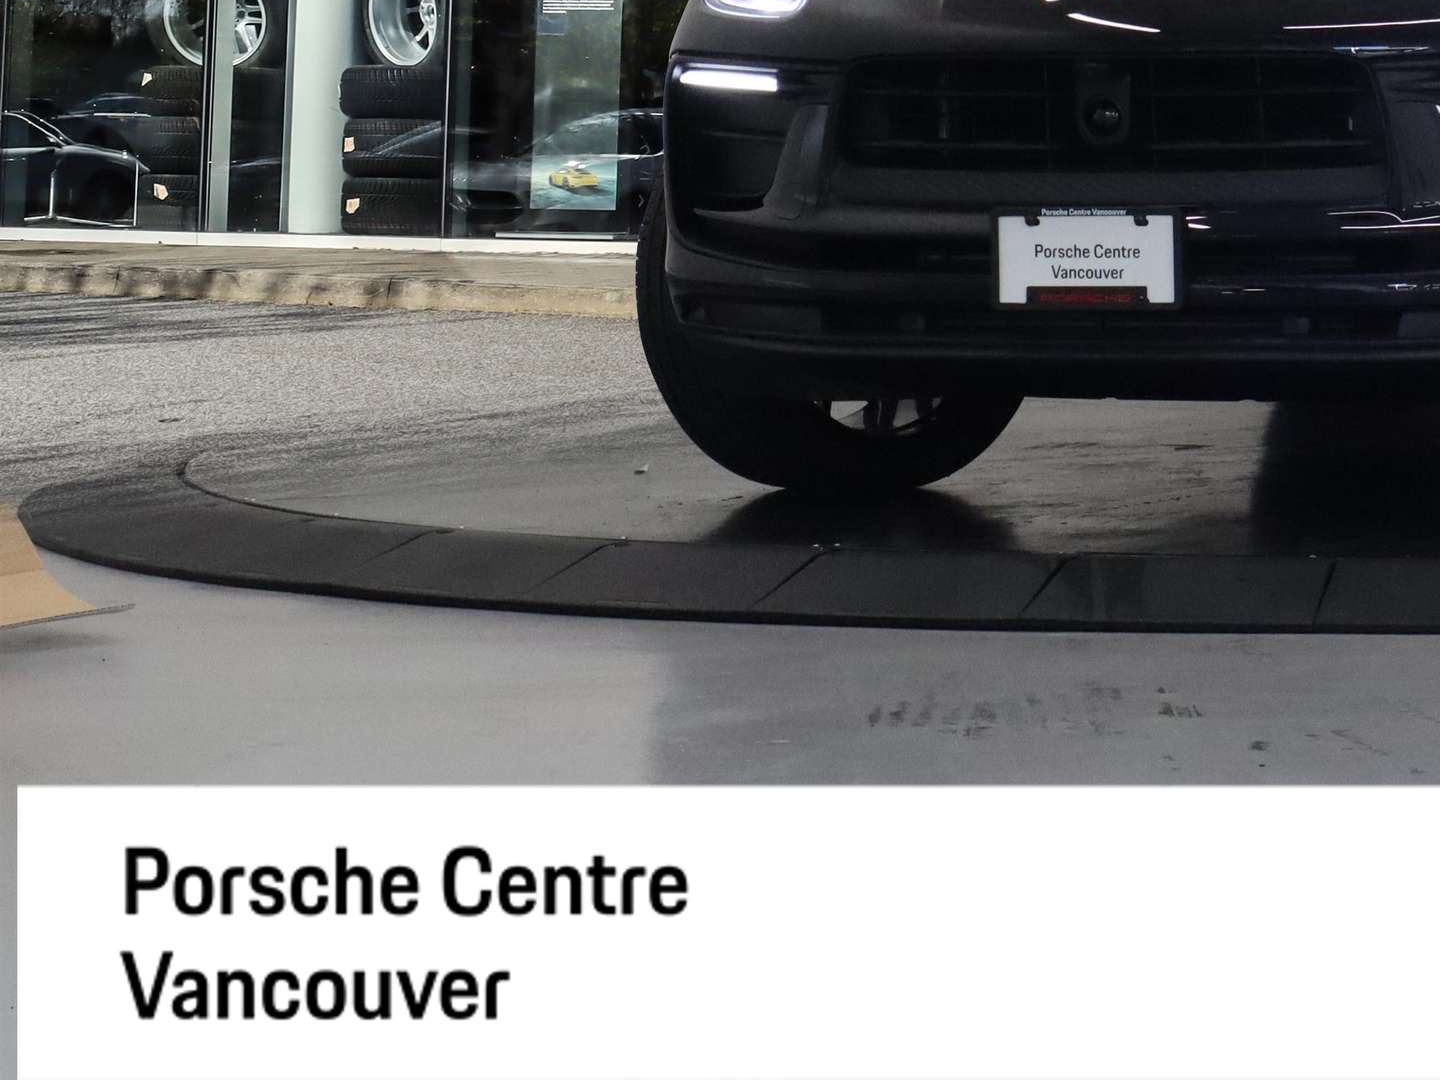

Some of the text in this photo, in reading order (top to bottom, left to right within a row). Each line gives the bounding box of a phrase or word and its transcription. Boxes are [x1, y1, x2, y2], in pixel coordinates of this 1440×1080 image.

[1041, 208, 1068, 216] Porsche
[1069, 208, 1092, 216] Centre
[1034, 244, 1141, 259] Porsche Centre
[1051, 265, 1125, 280] Vancouver
